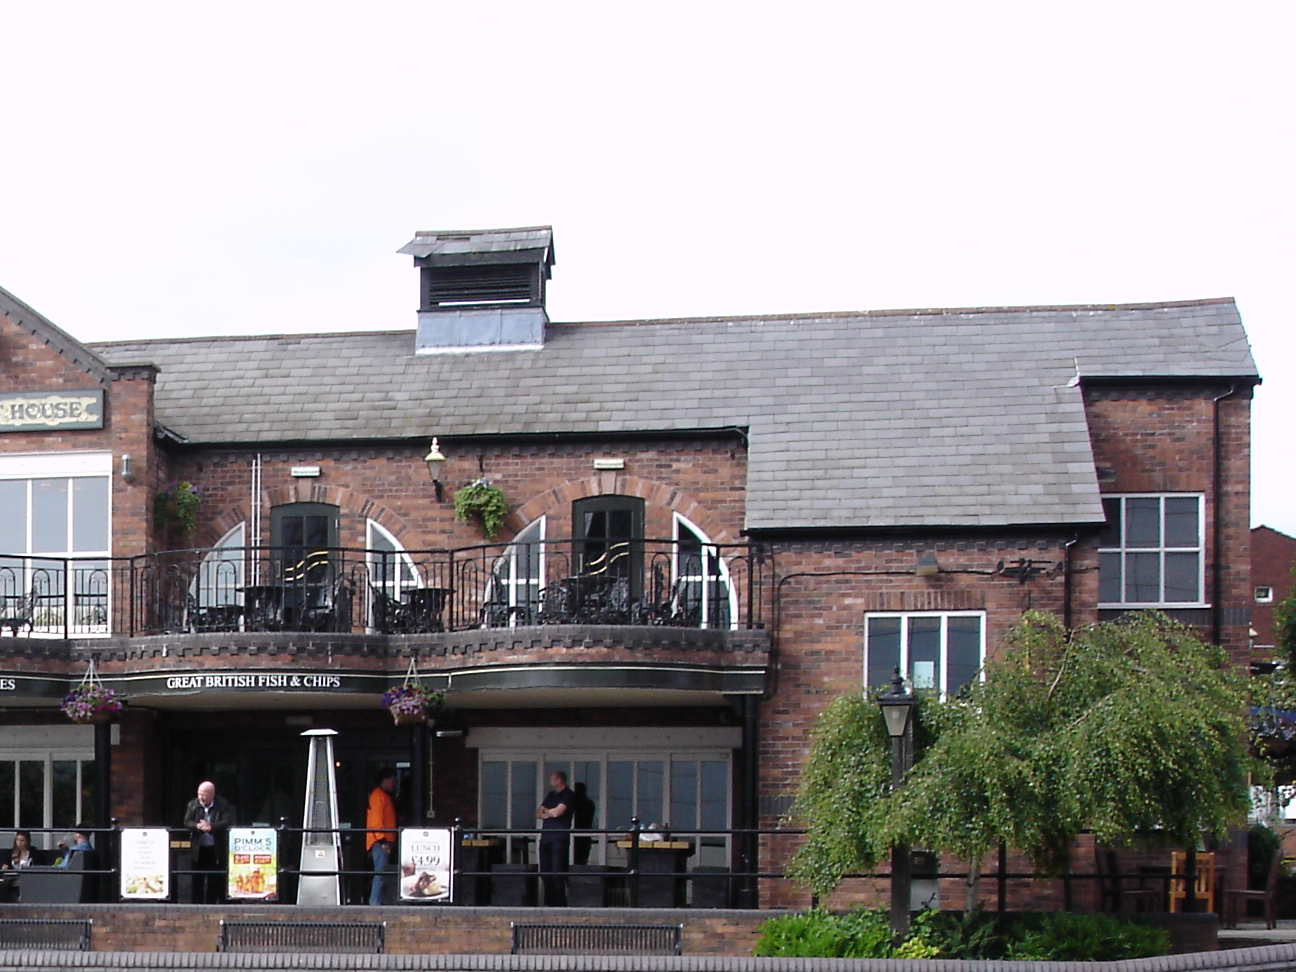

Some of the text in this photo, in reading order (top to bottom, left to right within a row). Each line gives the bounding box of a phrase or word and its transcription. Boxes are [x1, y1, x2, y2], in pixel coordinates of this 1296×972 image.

[11, 401, 82, 420] HOUSE
[167, 675, 341, 689] GREAT BRITISH FISH & CHIPS
[234, 838, 272, 846] PIMM'S
